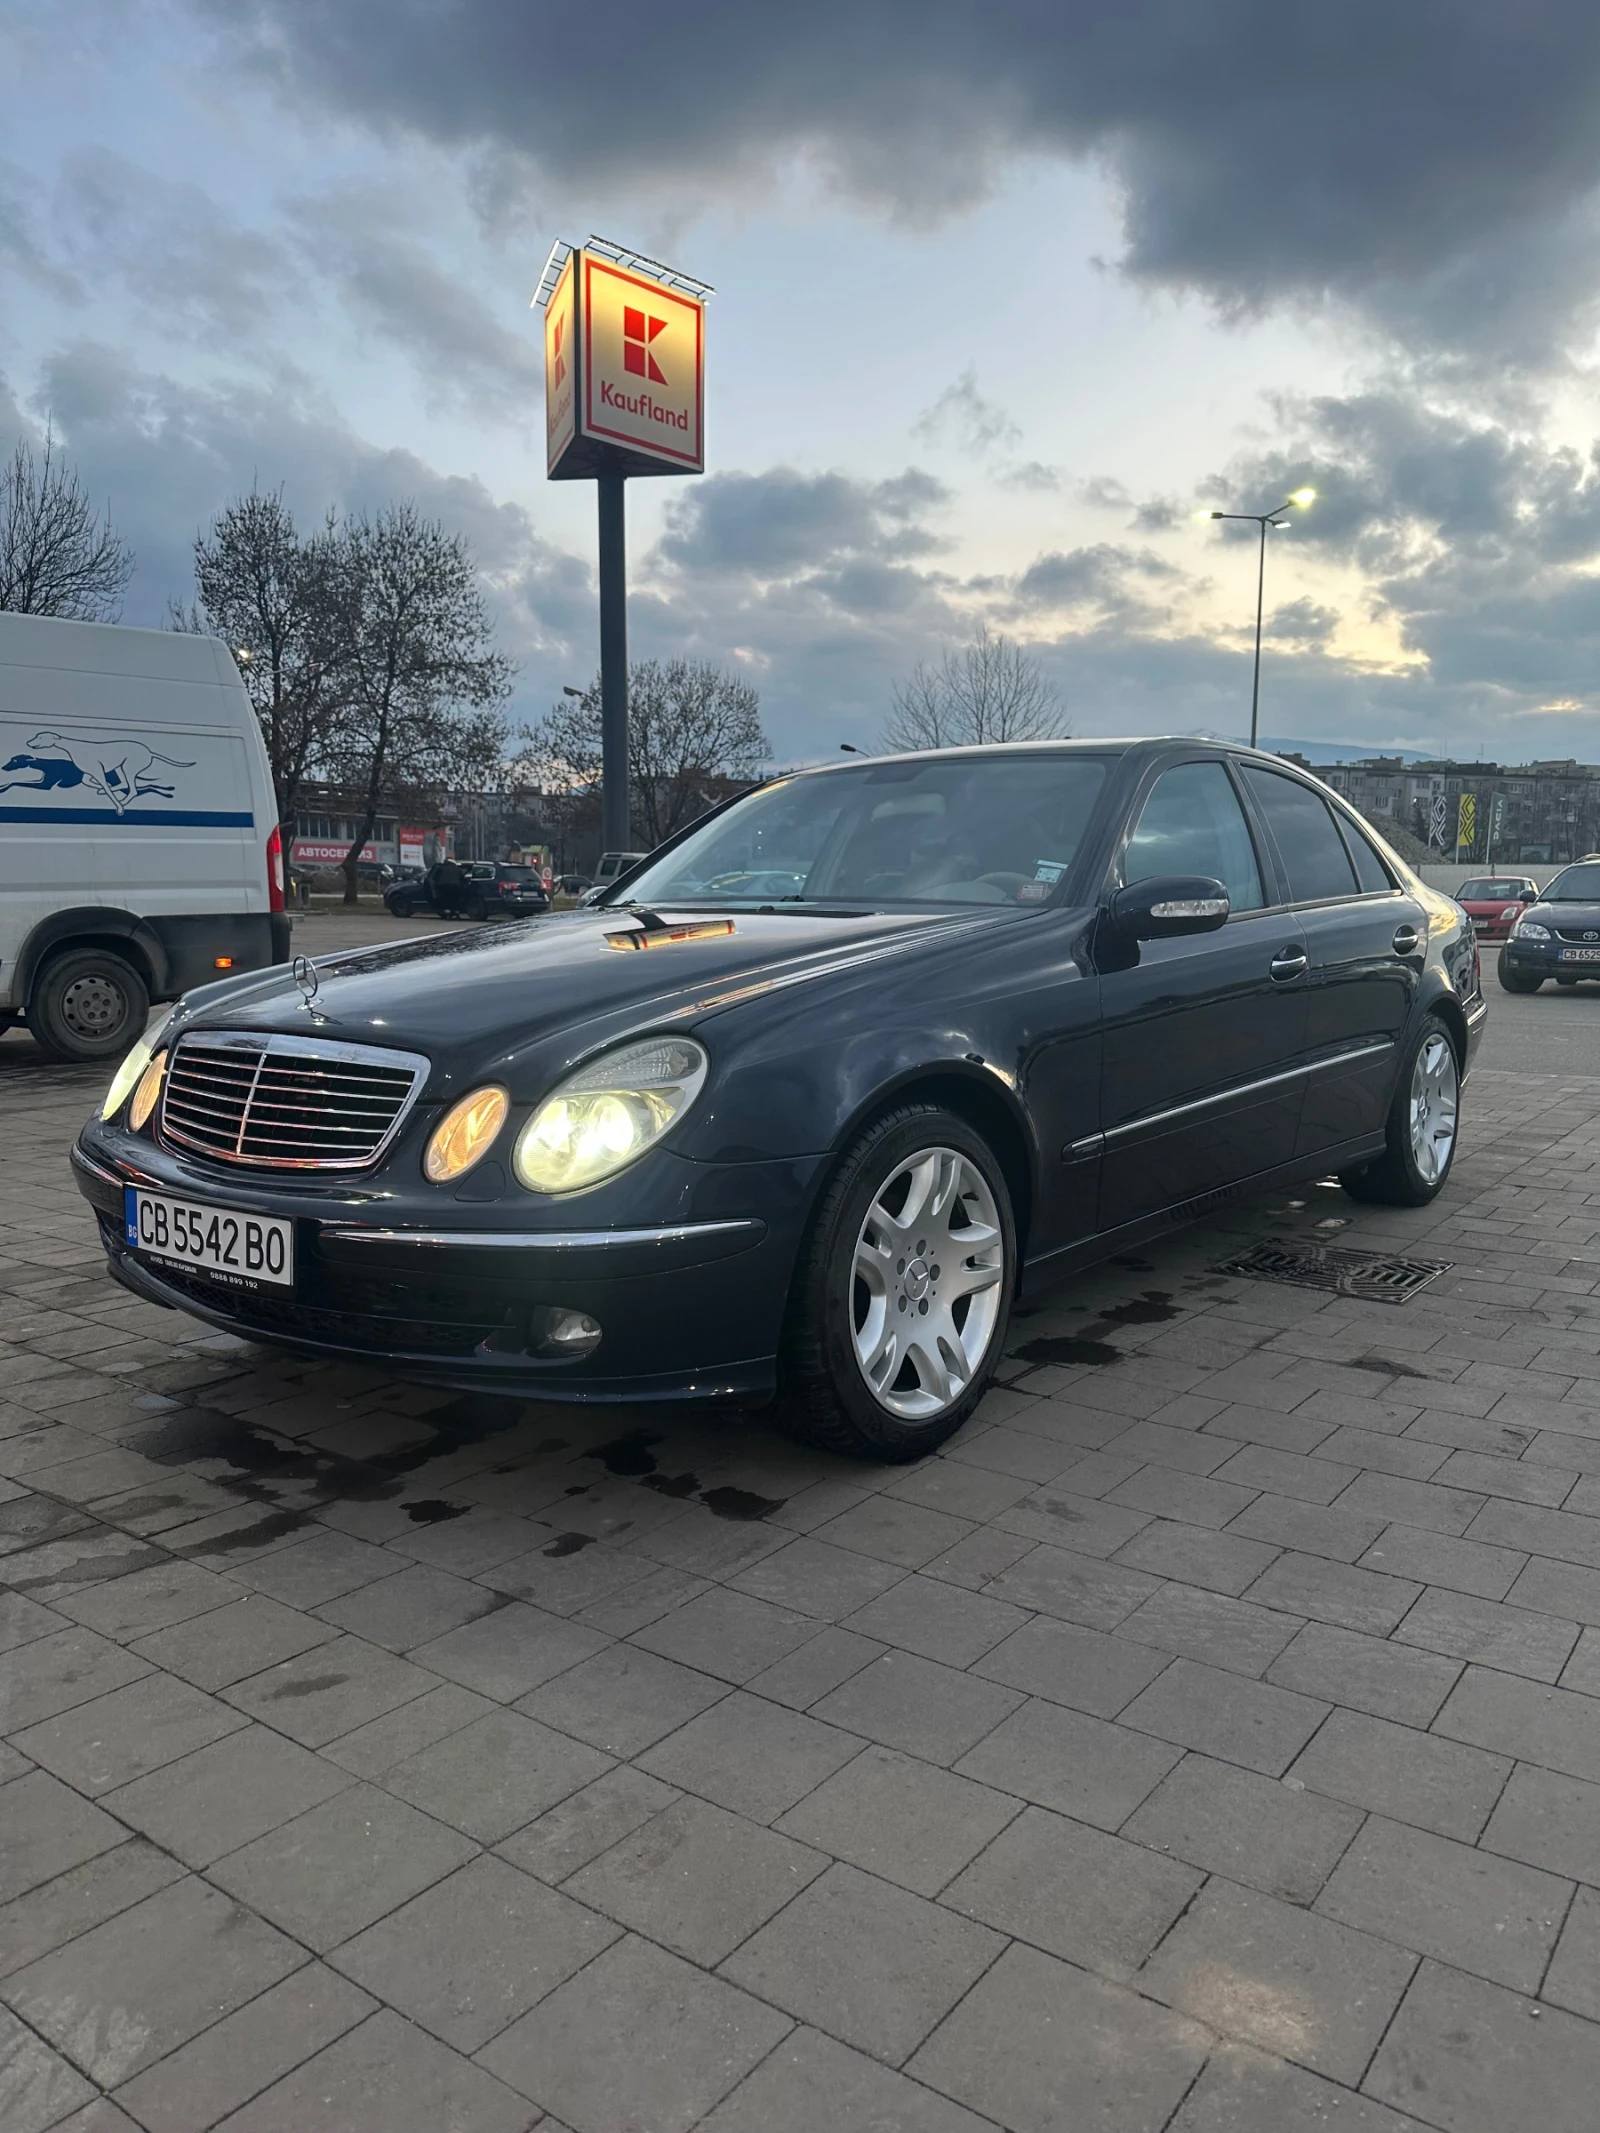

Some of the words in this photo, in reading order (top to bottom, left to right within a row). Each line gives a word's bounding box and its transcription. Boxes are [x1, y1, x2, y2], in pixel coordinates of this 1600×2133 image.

[601, 380, 688, 431] Kaufland
[298, 847, 373, 859] АВТОСЕРИЗ
[128, 1224, 137, 1238] BG
[245, 1280, 258, 1289] 192
